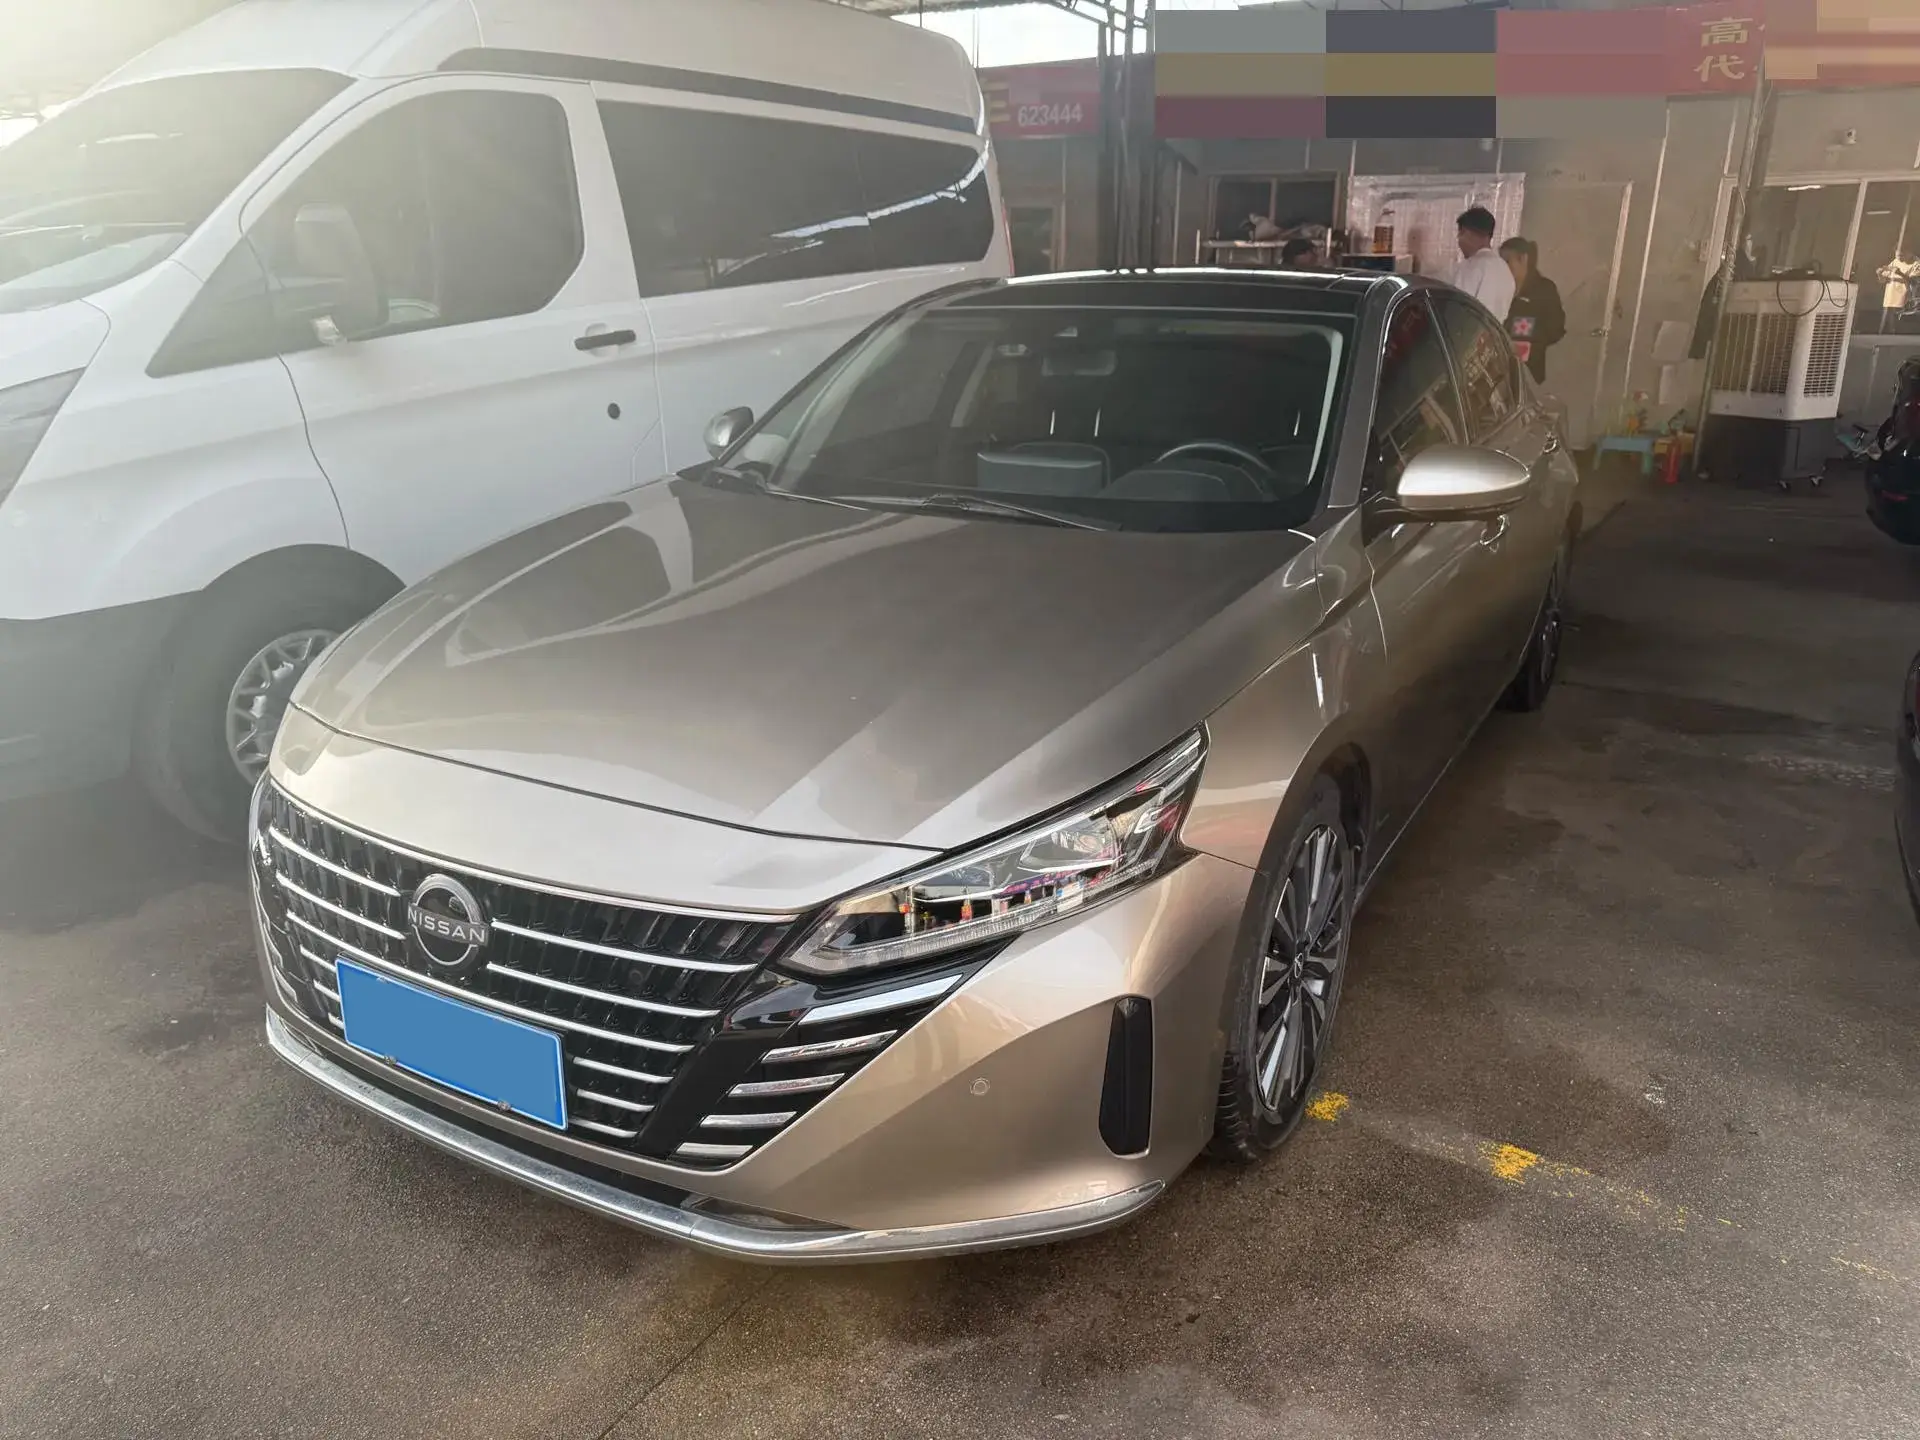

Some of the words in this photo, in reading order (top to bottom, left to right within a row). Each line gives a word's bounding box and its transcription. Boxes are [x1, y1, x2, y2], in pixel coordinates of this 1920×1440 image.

[1701, 16, 1754, 48] 高
[1693, 54, 1745, 83] 代
[1018, 102, 1084, 127] 623444
[407, 903, 485, 943] NISSAN
